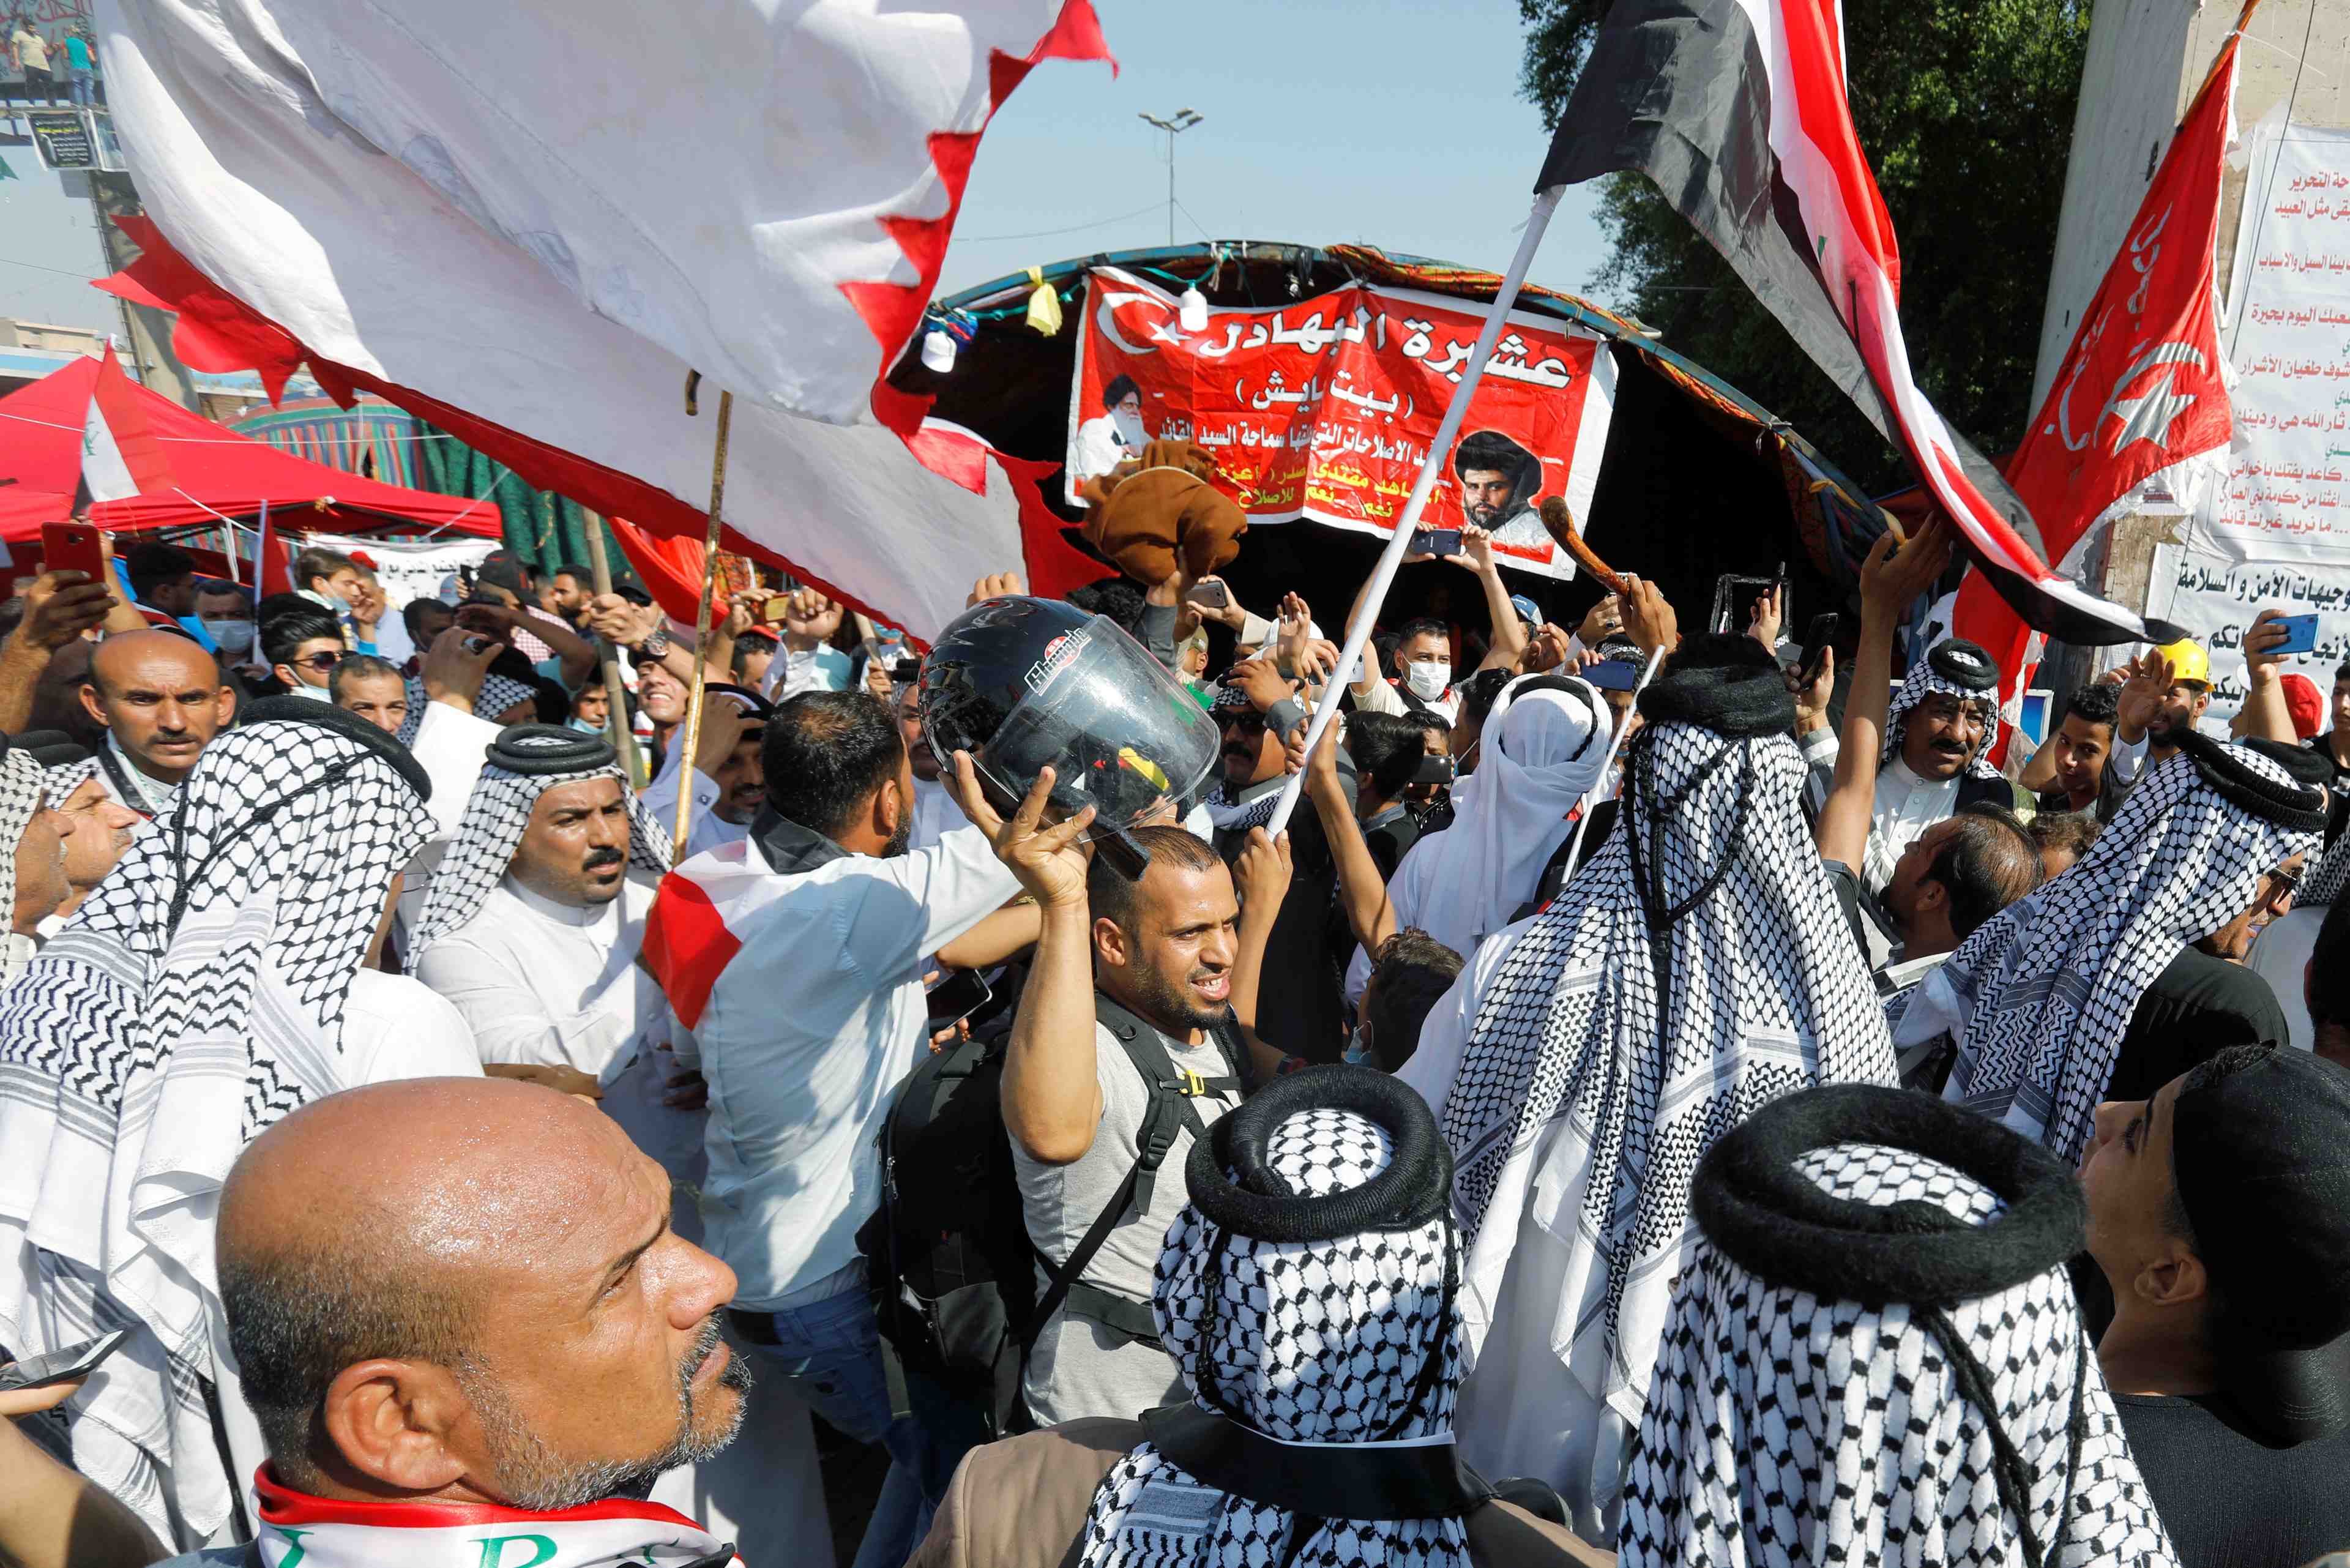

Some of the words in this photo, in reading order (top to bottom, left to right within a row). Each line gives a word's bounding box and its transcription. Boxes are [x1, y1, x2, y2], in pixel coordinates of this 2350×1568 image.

[2288, 171, 2330, 191] التحرير
[2275, 199, 2306, 218] العبيد
[2307, 196, 2330, 219] مثل
[2298, 253, 2328, 272] السبل
[2251, 303, 2285, 326] بحيرة
[2286, 307, 2317, 327] اليوم
[1197, 305, 1387, 357] البهادل
[2283, 359, 2321, 379] طغيان
[2278, 414, 2299, 433] هي
[2302, 409, 2324, 428] الله
[2323, 411, 2345, 432] ثار
[1198, 424, 1237, 452] السيد
[1240, 420, 1285, 447] سماحة
[1310, 421, 1342, 451] التي
[1343, 427, 1412, 463] الاصلاحات
[1313, 461, 1369, 488] مقتدى
[2274, 461, 2303, 483] يفتك
[2305, 466, 2342, 482] كاعد
[1237, 487, 1294, 509] للاصلاح
[1305, 485, 1335, 504] نعم
[2248, 488, 2264, 509] بني
[2265, 487, 2301, 507] حكومة
[2302, 493, 2316, 510] من
[1362, 501, 1393, 519] نعم
[2218, 509, 2246, 525] قائد
[2248, 513, 2283, 533] غيرك
[2286, 515, 2315, 534] نريد
[2319, 517, 2332, 532] ما
[2177, 562, 2237, 593] السلامة
[2248, 569, 2290, 603] الأمن
[2236, 579, 2247, 602] و
